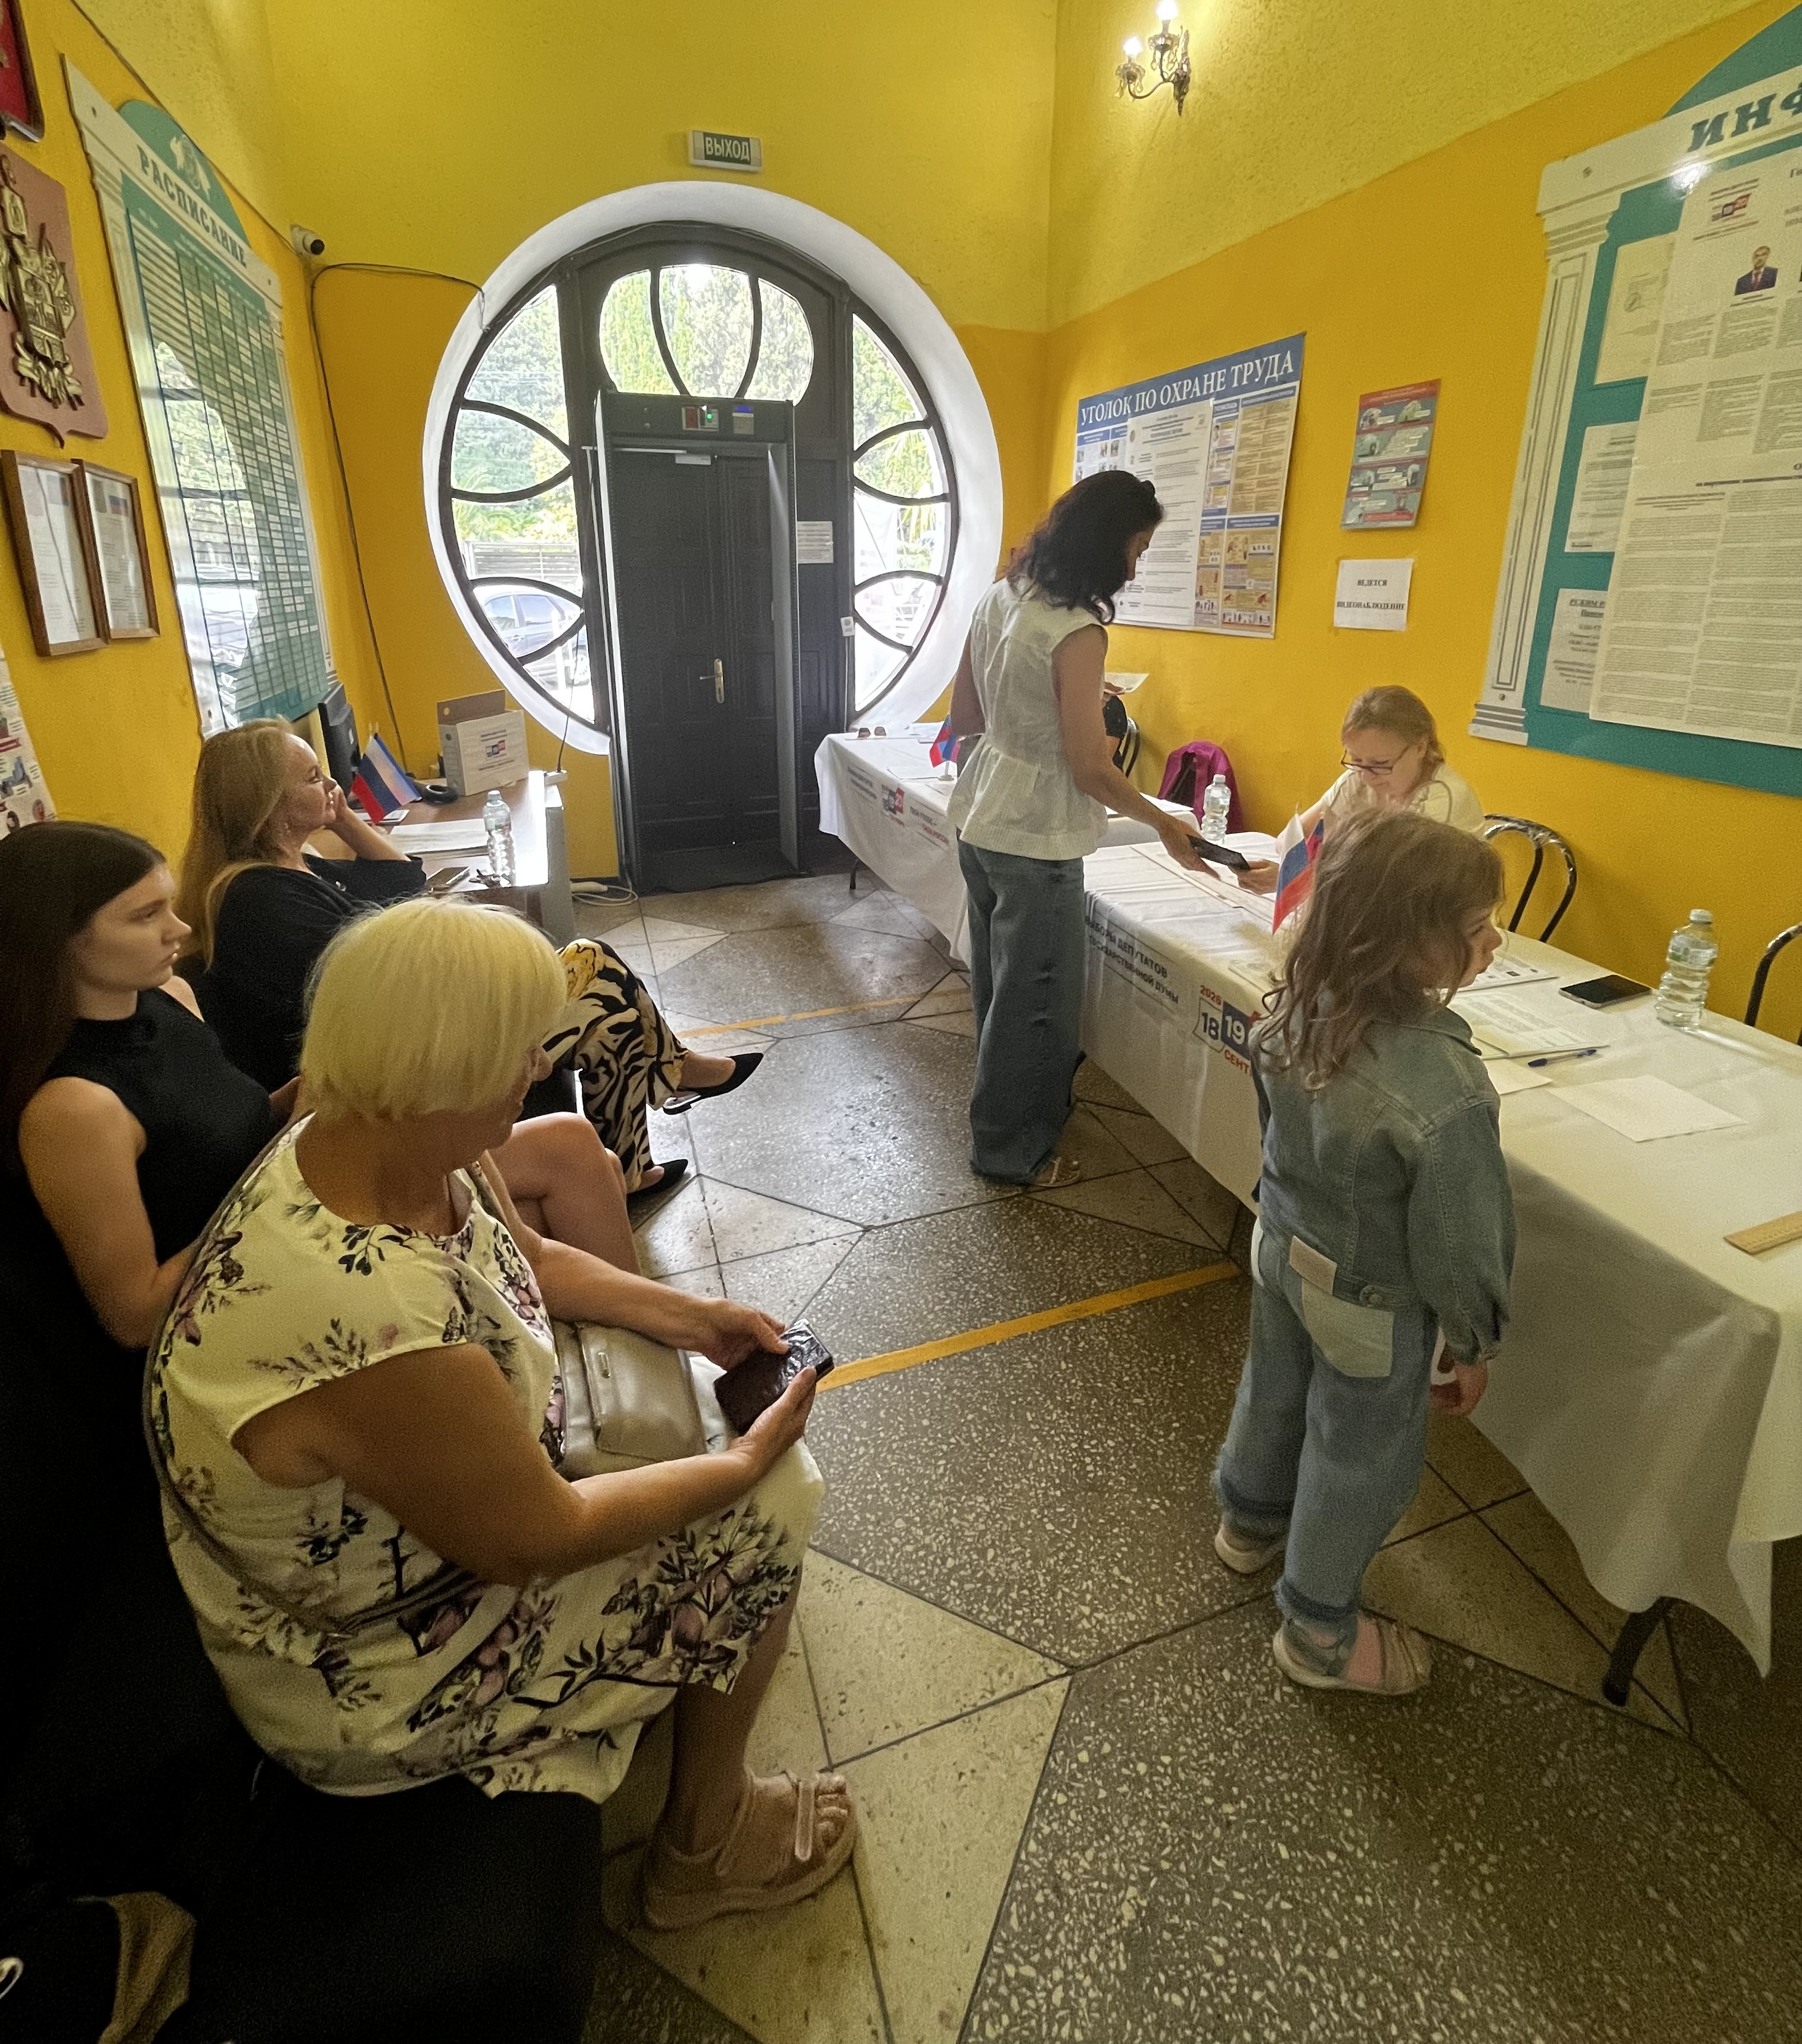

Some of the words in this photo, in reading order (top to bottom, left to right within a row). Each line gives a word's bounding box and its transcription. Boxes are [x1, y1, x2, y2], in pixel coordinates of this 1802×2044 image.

[706, 136, 750, 161] ВЫХОД
[136, 144, 247, 268] РАСПИСАНИЕ
[1081, 395, 1132, 425] УГОЛОК
[1135, 389, 1157, 412] ПО
[1160, 369, 1226, 406] ОХРАНЕ
[1230, 350, 1294, 388] ТРУДА
[1357, 579, 1387, 587] ВЕДЕТСЯ
[1155, 981, 1179, 1004] ДУМЫ
[1200, 984, 1222, 1005] 2026
[1201, 1012, 1219, 1040] 18
[1225, 1015, 1245, 1045] 19
[1224, 1049, 1253, 1076] СЕНТ
